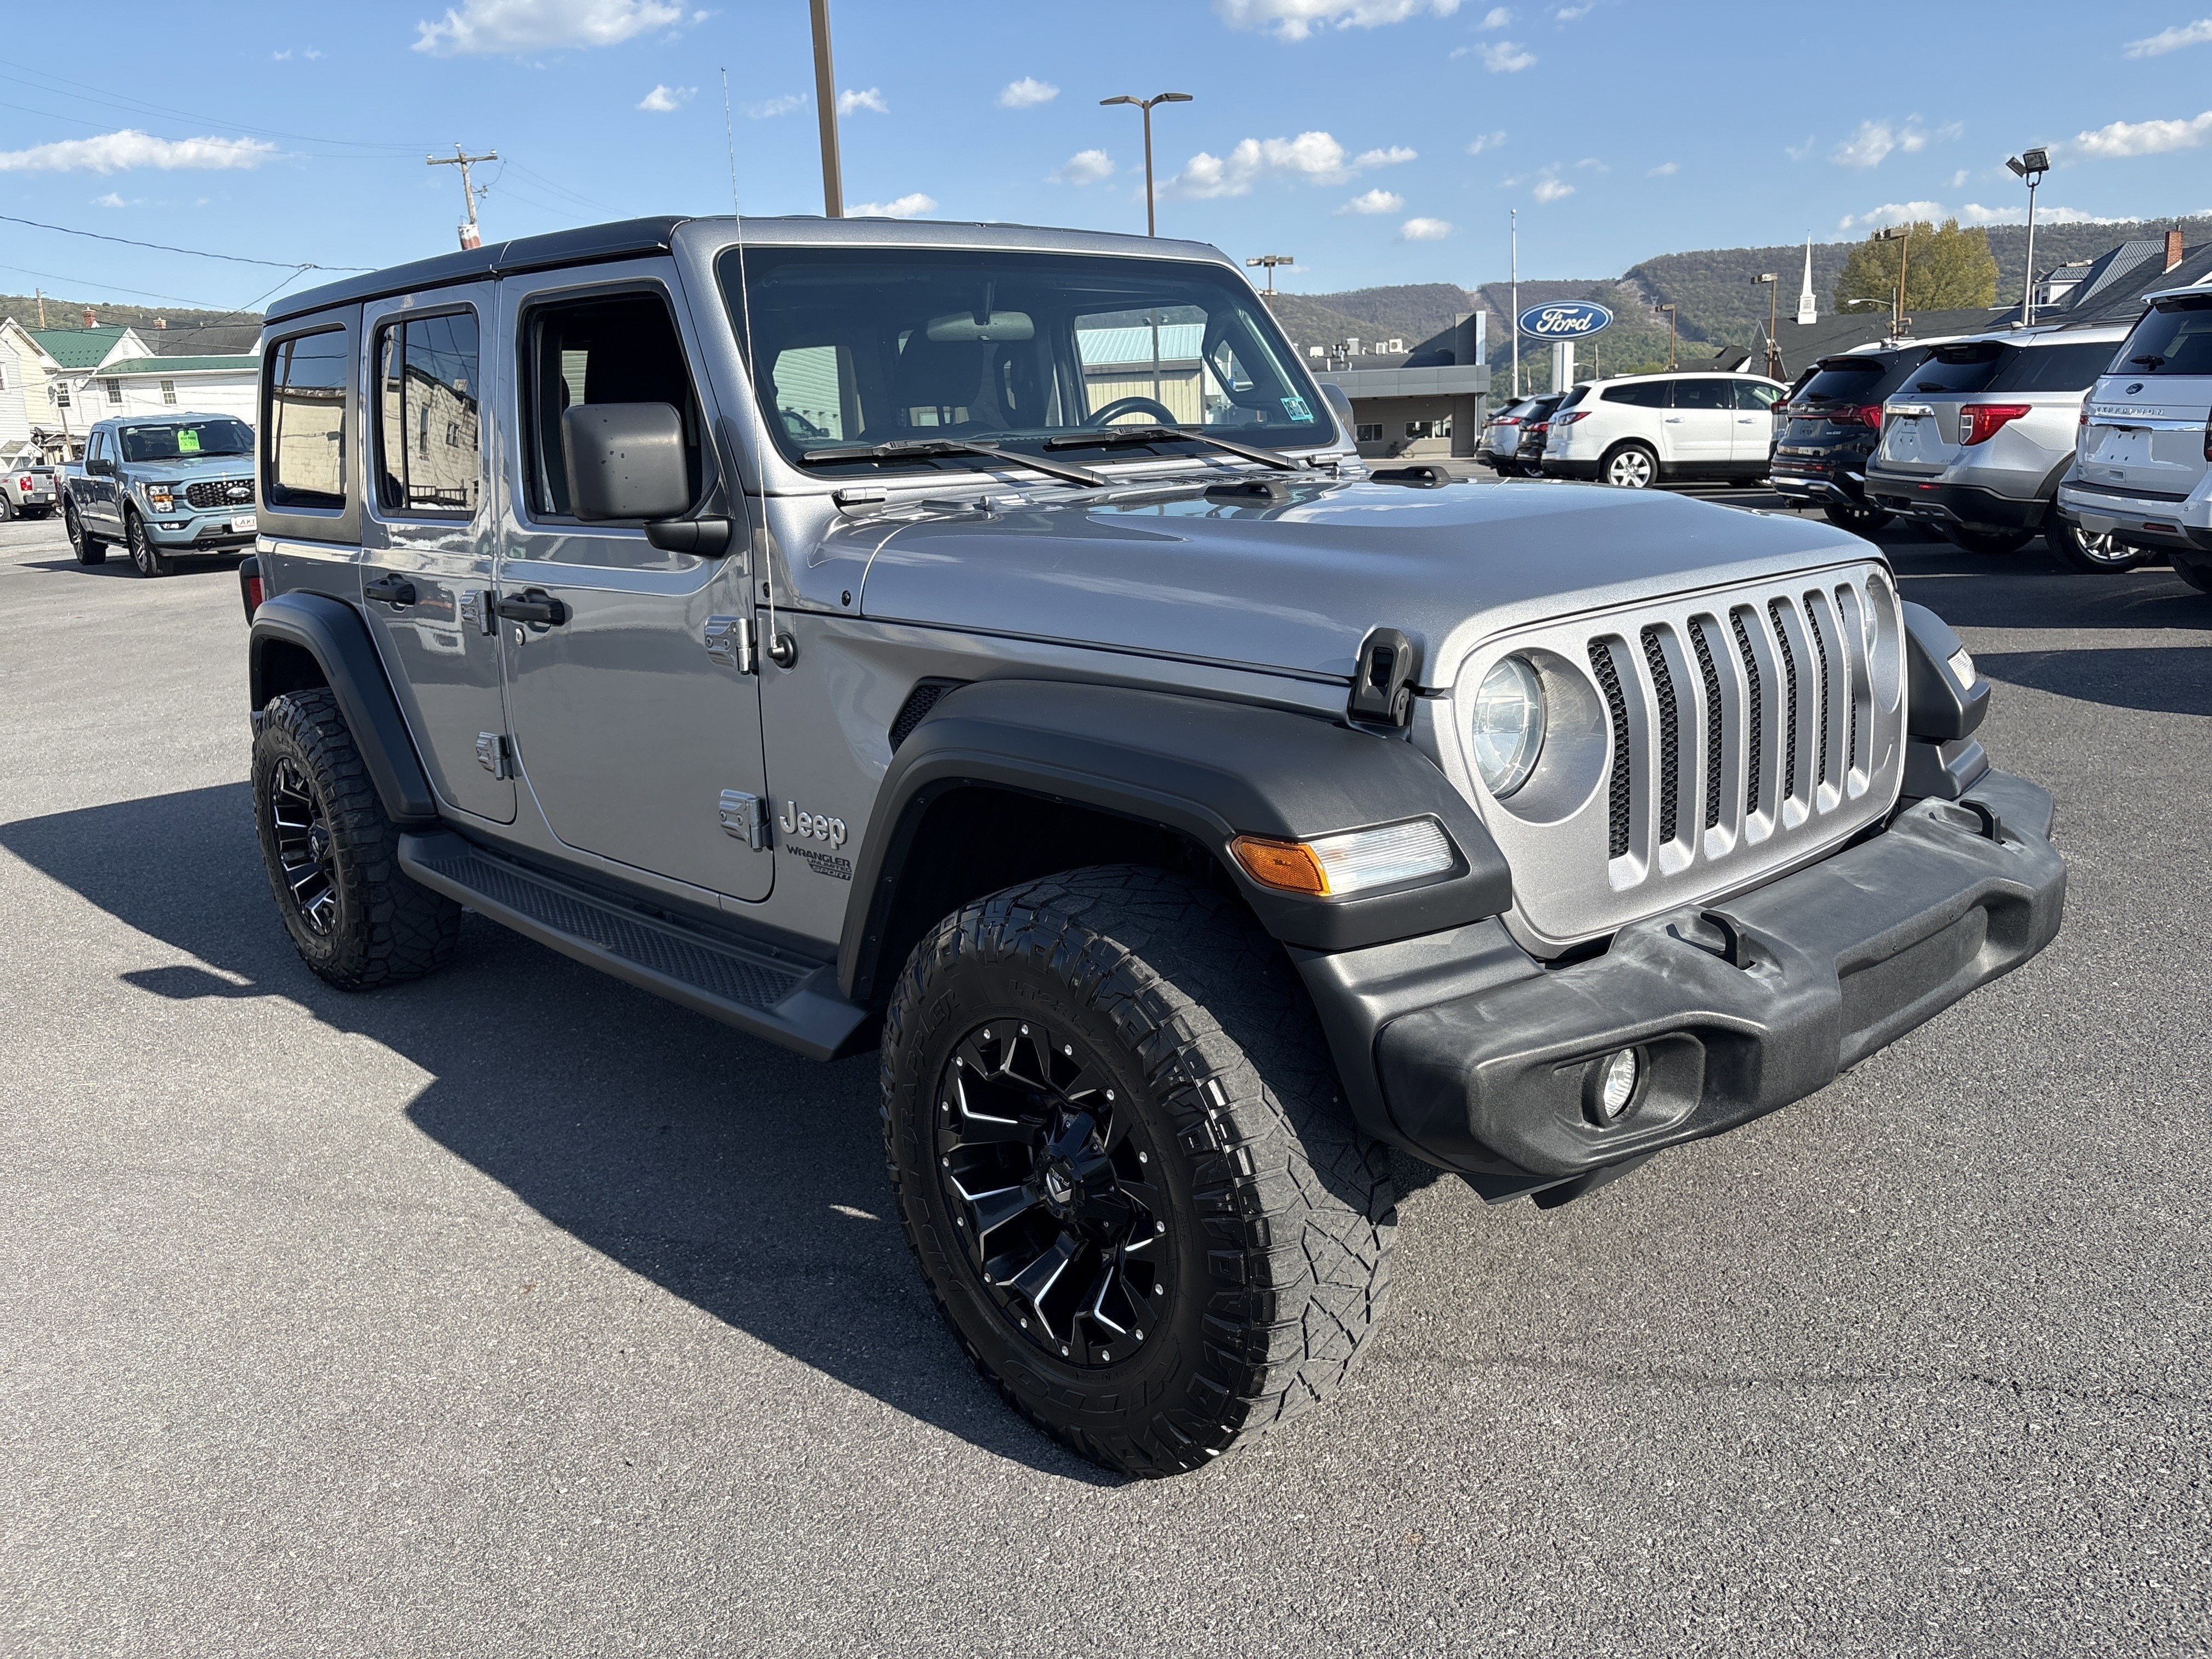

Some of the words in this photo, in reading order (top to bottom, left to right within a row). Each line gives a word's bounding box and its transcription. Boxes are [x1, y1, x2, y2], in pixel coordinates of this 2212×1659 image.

[1536, 308, 1593, 332] Ford
[779, 800, 848, 850] Jeep
[786, 844, 851, 868] WRANGLER
[806, 857, 853, 873] UNLIMITED
[811, 865, 851, 880] SPORT
[1049, 1166, 1070, 1187] FUEL
